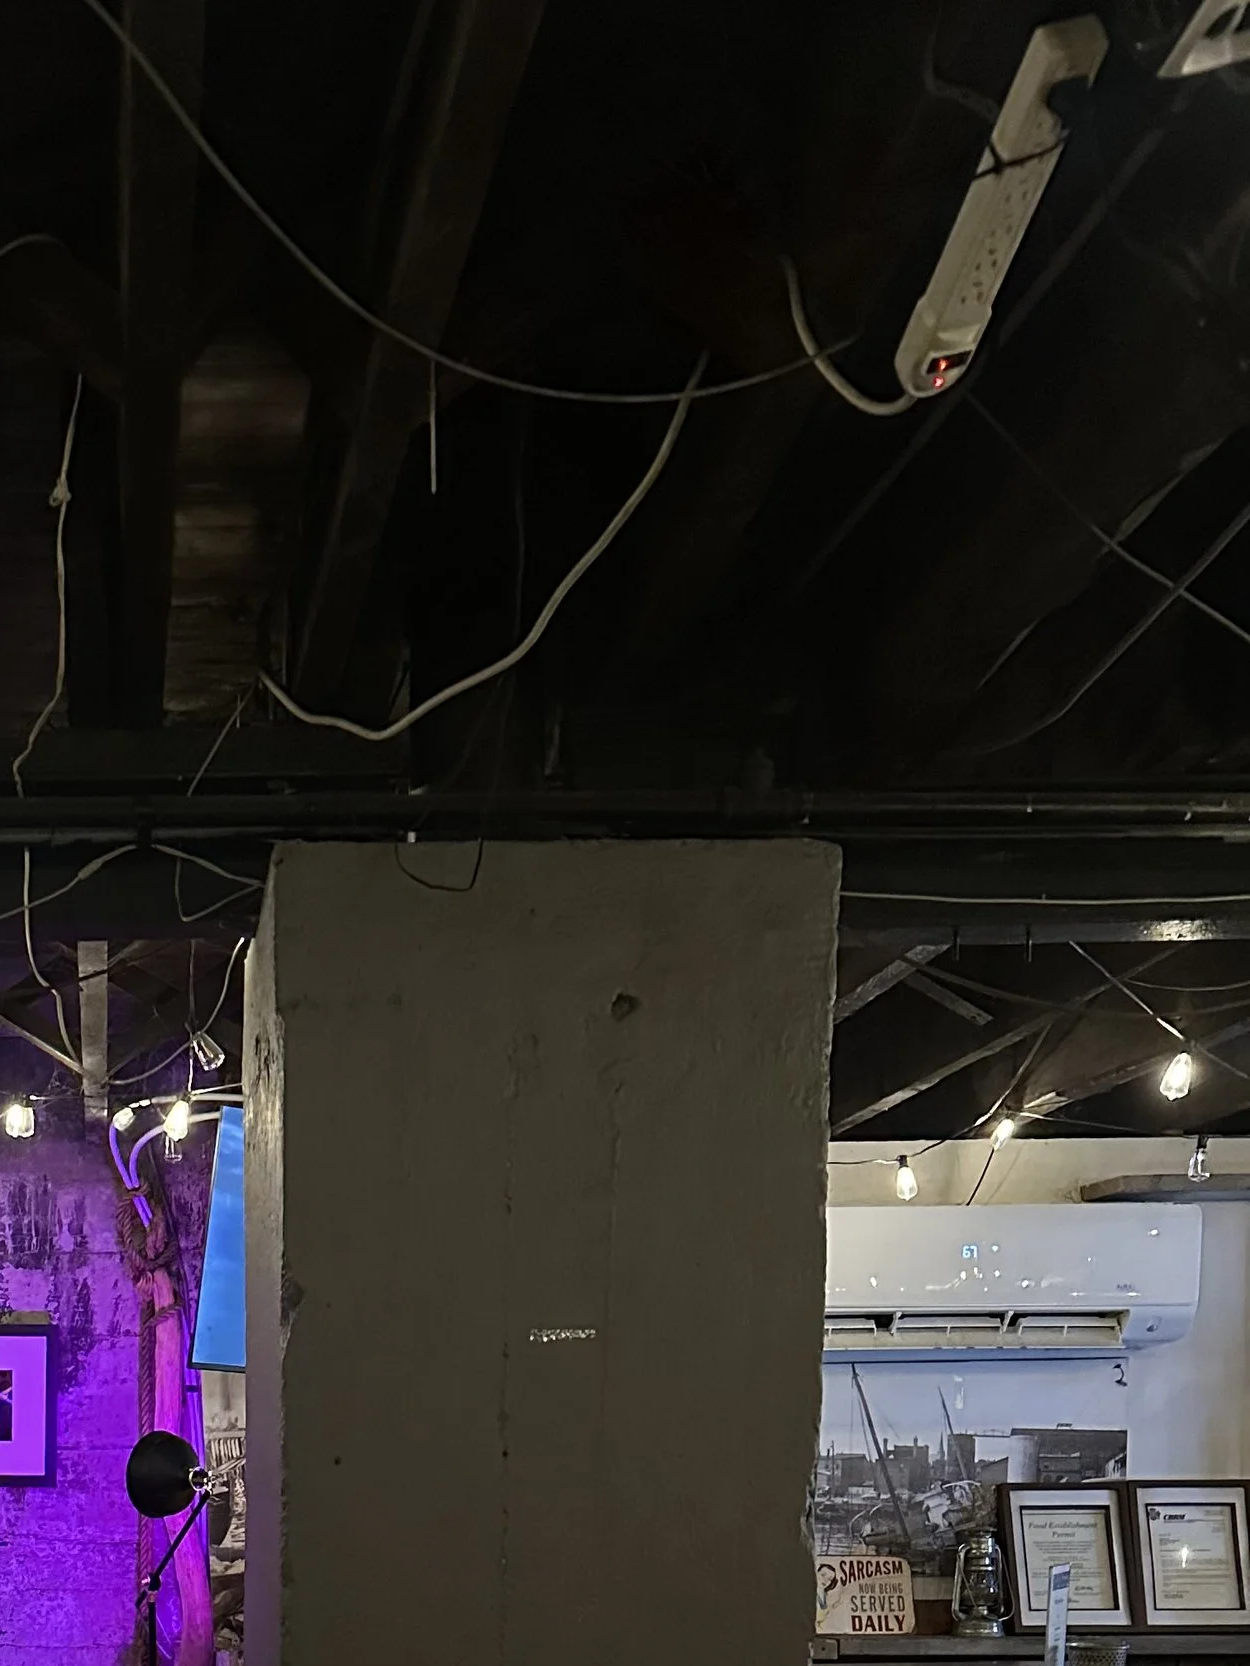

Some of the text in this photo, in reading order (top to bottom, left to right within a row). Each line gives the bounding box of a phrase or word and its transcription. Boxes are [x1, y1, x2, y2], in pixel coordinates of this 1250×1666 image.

[962, 1245, 978, 1258] 67
[839, 1560, 903, 1587] SARCASM
[859, 1583, 903, 1594] NOW BEING
[851, 1595, 905, 1613] SERVED
[851, 1615, 905, 1632] DAILY
